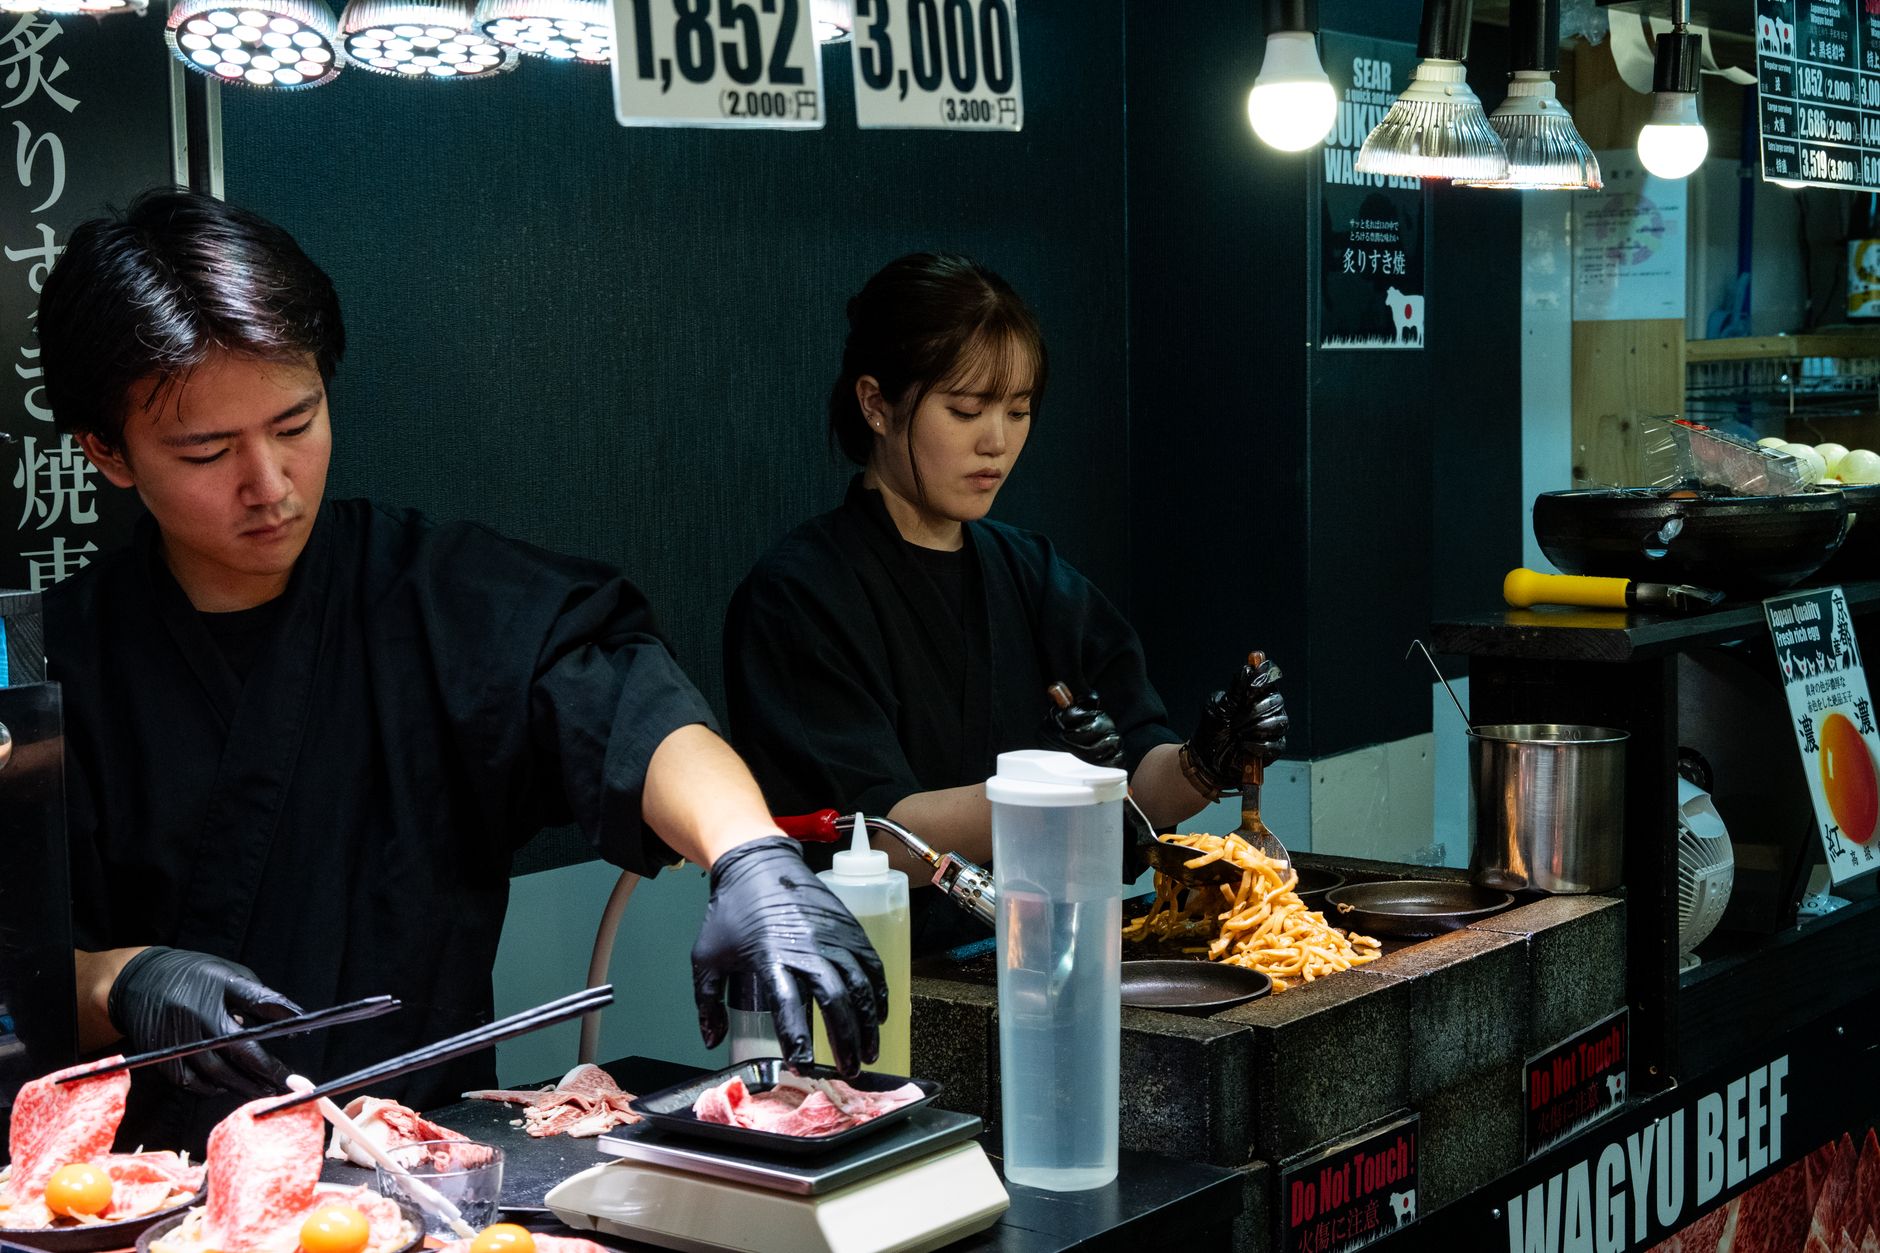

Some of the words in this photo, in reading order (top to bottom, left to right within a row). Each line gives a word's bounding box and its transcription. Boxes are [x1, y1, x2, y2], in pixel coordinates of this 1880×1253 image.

[632, 0, 806, 94] 1,852
[855, 0, 1014, 102] 3,000
[1353, 57, 1392, 91] SEAR
[1798, 66, 1823, 97] 1,852
[1800, 107, 1826, 139] 2,686
[1802, 149, 1827, 179] 3,519
[1342, 248, 1406, 275] 炙りすき焼
[1769, 607, 1794, 628] Japan
[1792, 601, 1821, 625] Quality
[1775, 629, 1794, 647] Fresh
[1794, 626, 1808, 642] rich
[1808, 625, 1821, 641] egg
[1531, 1069, 1551, 1111] Do
[1552, 1051, 1577, 1098] Not
[1507, 1108, 1685, 1253] WAGYU
[1697, 1054, 1789, 1207] BEEF
[1291, 1180, 1316, 1228] Do
[1319, 1162, 1350, 1215] Not
[1298, 1198, 1380, 1253] 火傷に注意
